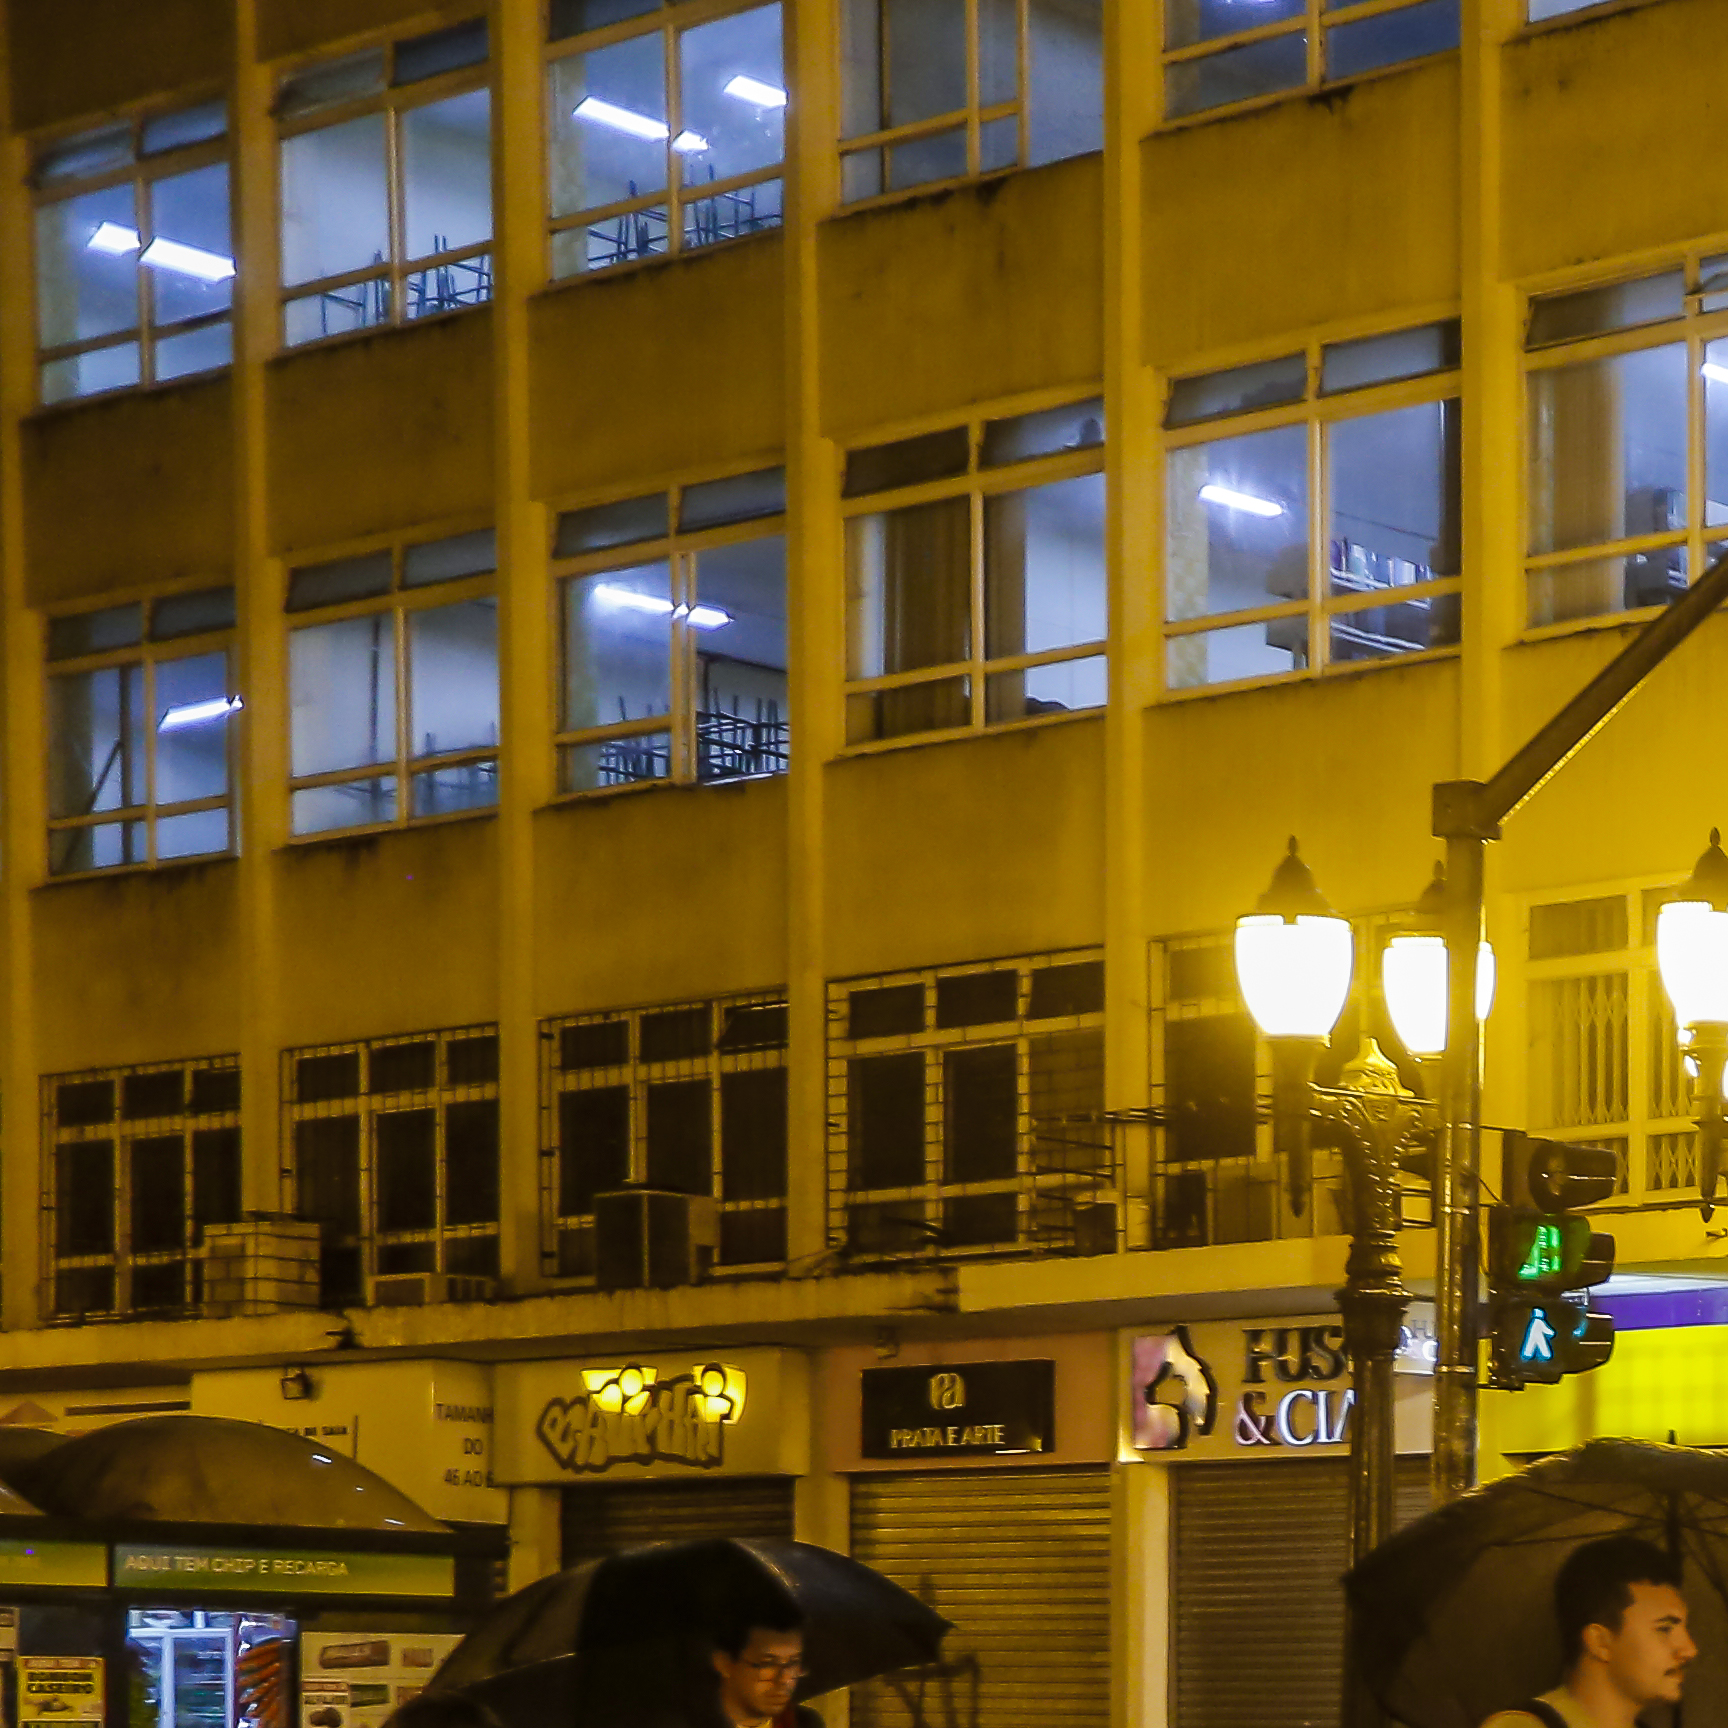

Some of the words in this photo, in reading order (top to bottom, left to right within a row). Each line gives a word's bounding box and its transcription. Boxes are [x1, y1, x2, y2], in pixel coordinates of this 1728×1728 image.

[890, 1427, 943, 1448] PRATA
[947, 1426, 959, 1446] E
[961, 1424, 1006, 1446] ARTE
[125, 1553, 172, 1571] AQUI
[173, 1555, 212, 1573] TEM
[212, 1557, 257, 1574] CHIP
[259, 1558, 270, 1575] E
[272, 1559, 349, 1577] RECARGA
